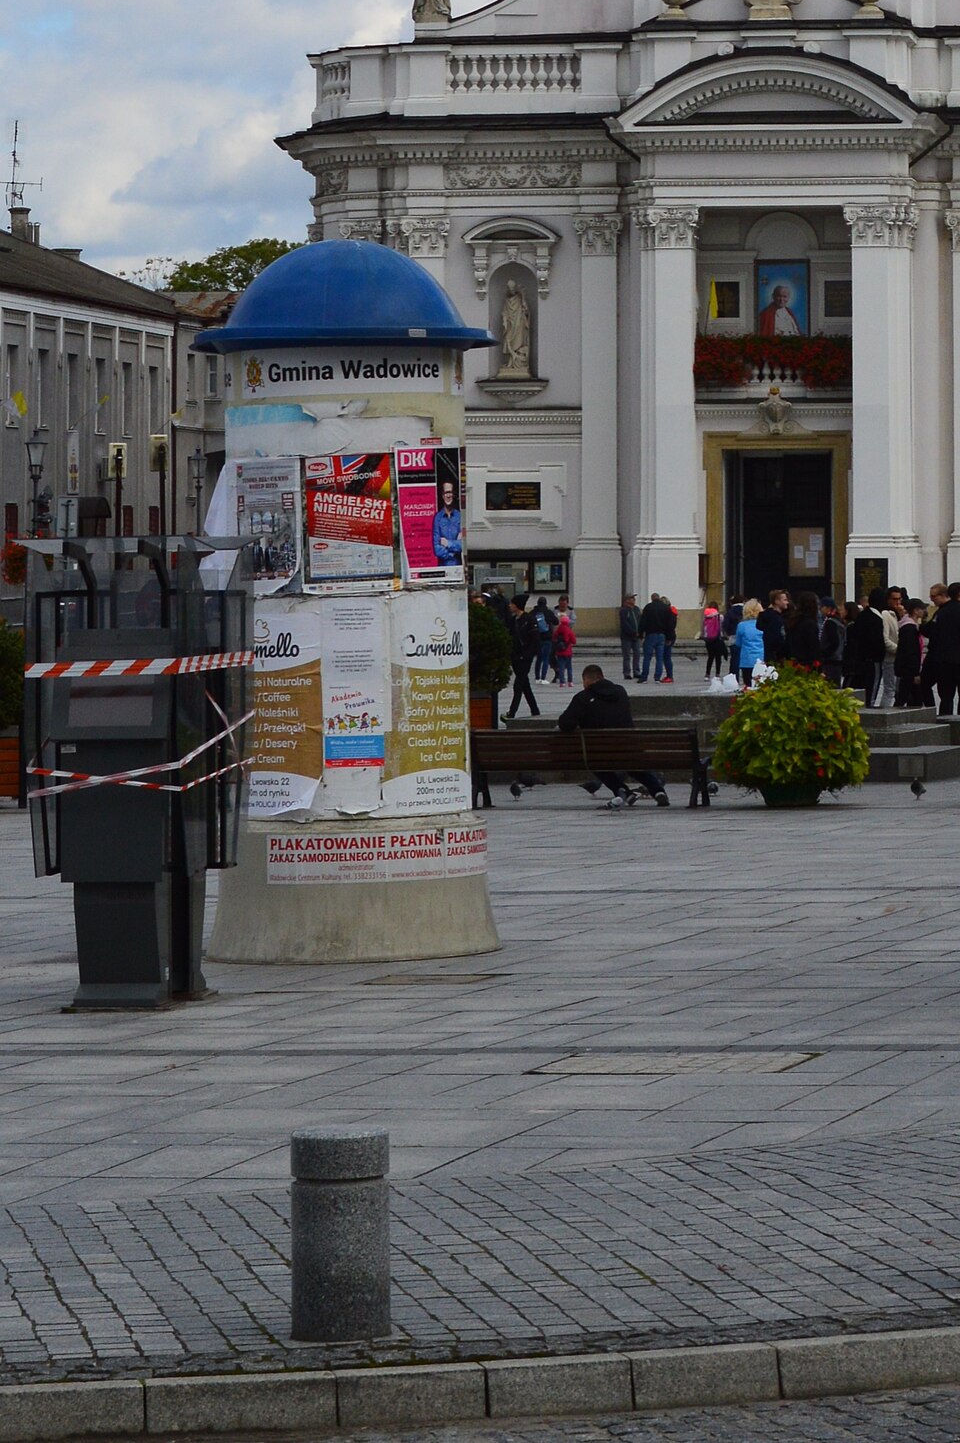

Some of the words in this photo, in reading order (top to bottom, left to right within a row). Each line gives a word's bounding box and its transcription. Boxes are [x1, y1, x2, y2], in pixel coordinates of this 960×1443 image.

[268, 360, 334, 384] Gmina
[340, 357, 440, 381] Wadowice
[336, 470, 382, 483] SWOBODNIE
[313, 492, 387, 510] ANGIELSKI
[313, 502, 385, 520] NIEMIECKI
[252, 632, 300, 658] mello
[401, 630, 464, 658] Carmello
[266, 677, 312, 687] Naturalne
[263, 692, 291, 702] Coffee
[331, 690, 363, 704] Akademia
[258, 706, 299, 718] Naleśniki
[263, 722, 306, 735] Przekąski
[265, 738, 297, 750] Desery
[257, 753, 285, 764] Cream
[420, 752, 433, 763] Ice
[434, 751, 457, 762] Cream
[252, 777, 280, 787] Lwowska
[280, 777, 290, 786] 22
[259, 788, 268, 797] od
[268, 788, 290, 800] rynku
[416, 786, 435, 796] 200m
[435, 785, 445, 795] od
[270, 835, 386, 851] PLAKATOWANIE
[390, 833, 441, 848] PŁATNE
[269, 853, 295, 863] ZAKAZ
[297, 850, 375, 863] SAMODZIELNEGO
[376, 848, 442, 861] PLAKATOWANIA
[447, 845, 466, 857] ZAKAZ
